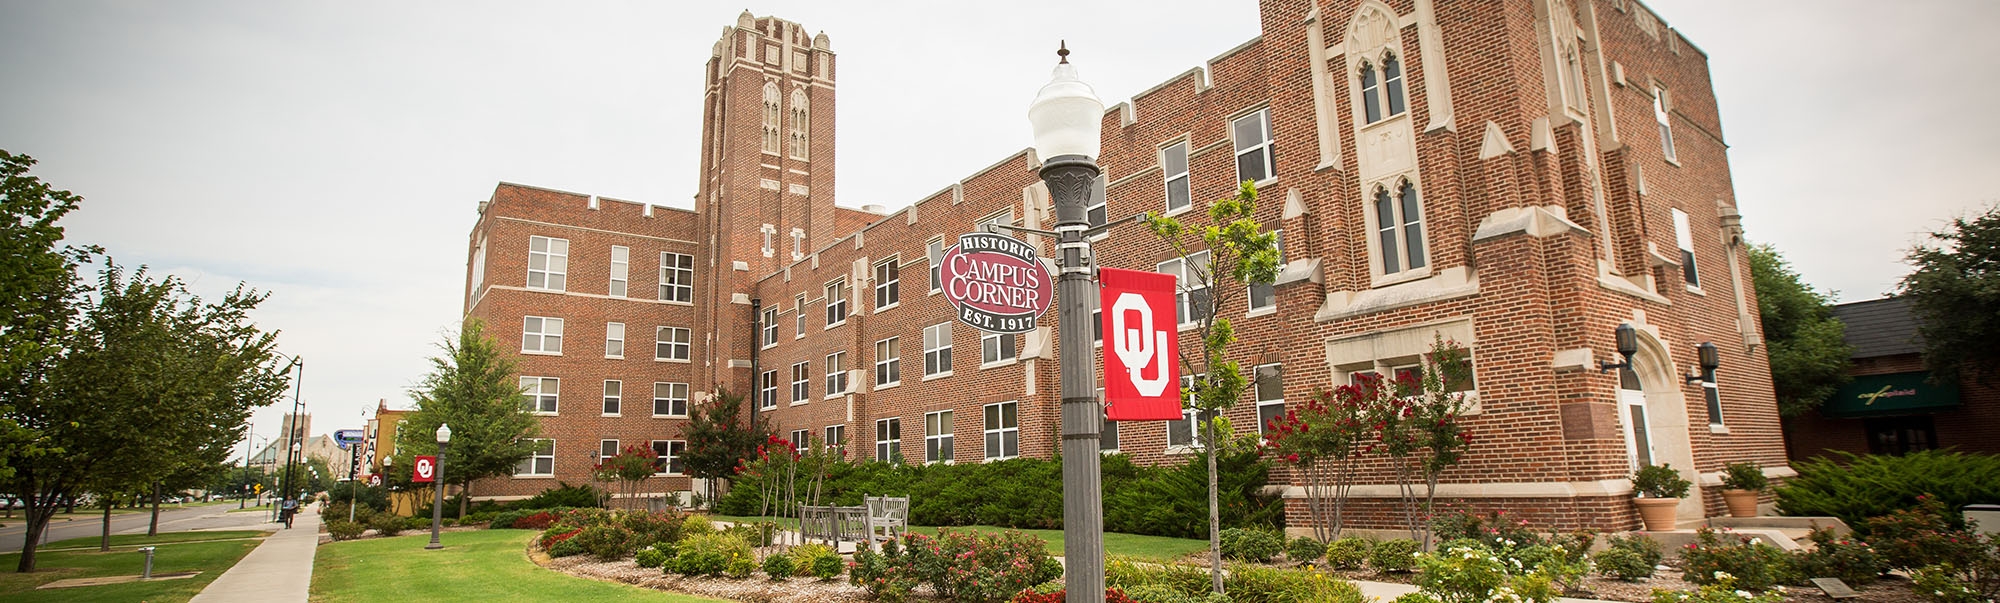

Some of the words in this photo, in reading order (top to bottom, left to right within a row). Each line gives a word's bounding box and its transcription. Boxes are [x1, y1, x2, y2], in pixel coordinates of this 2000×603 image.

[962, 236, 1034, 261] HISTORIC
[950, 254, 1040, 290] CAMPUS
[949, 276, 1040, 310] CORNER
[963, 308, 995, 329] EST.
[1000, 316, 1033, 331] 1917
[1112, 292, 1170, 397] OU
[365, 428, 377, 466] JAX
[417, 459, 433, 478] OU
